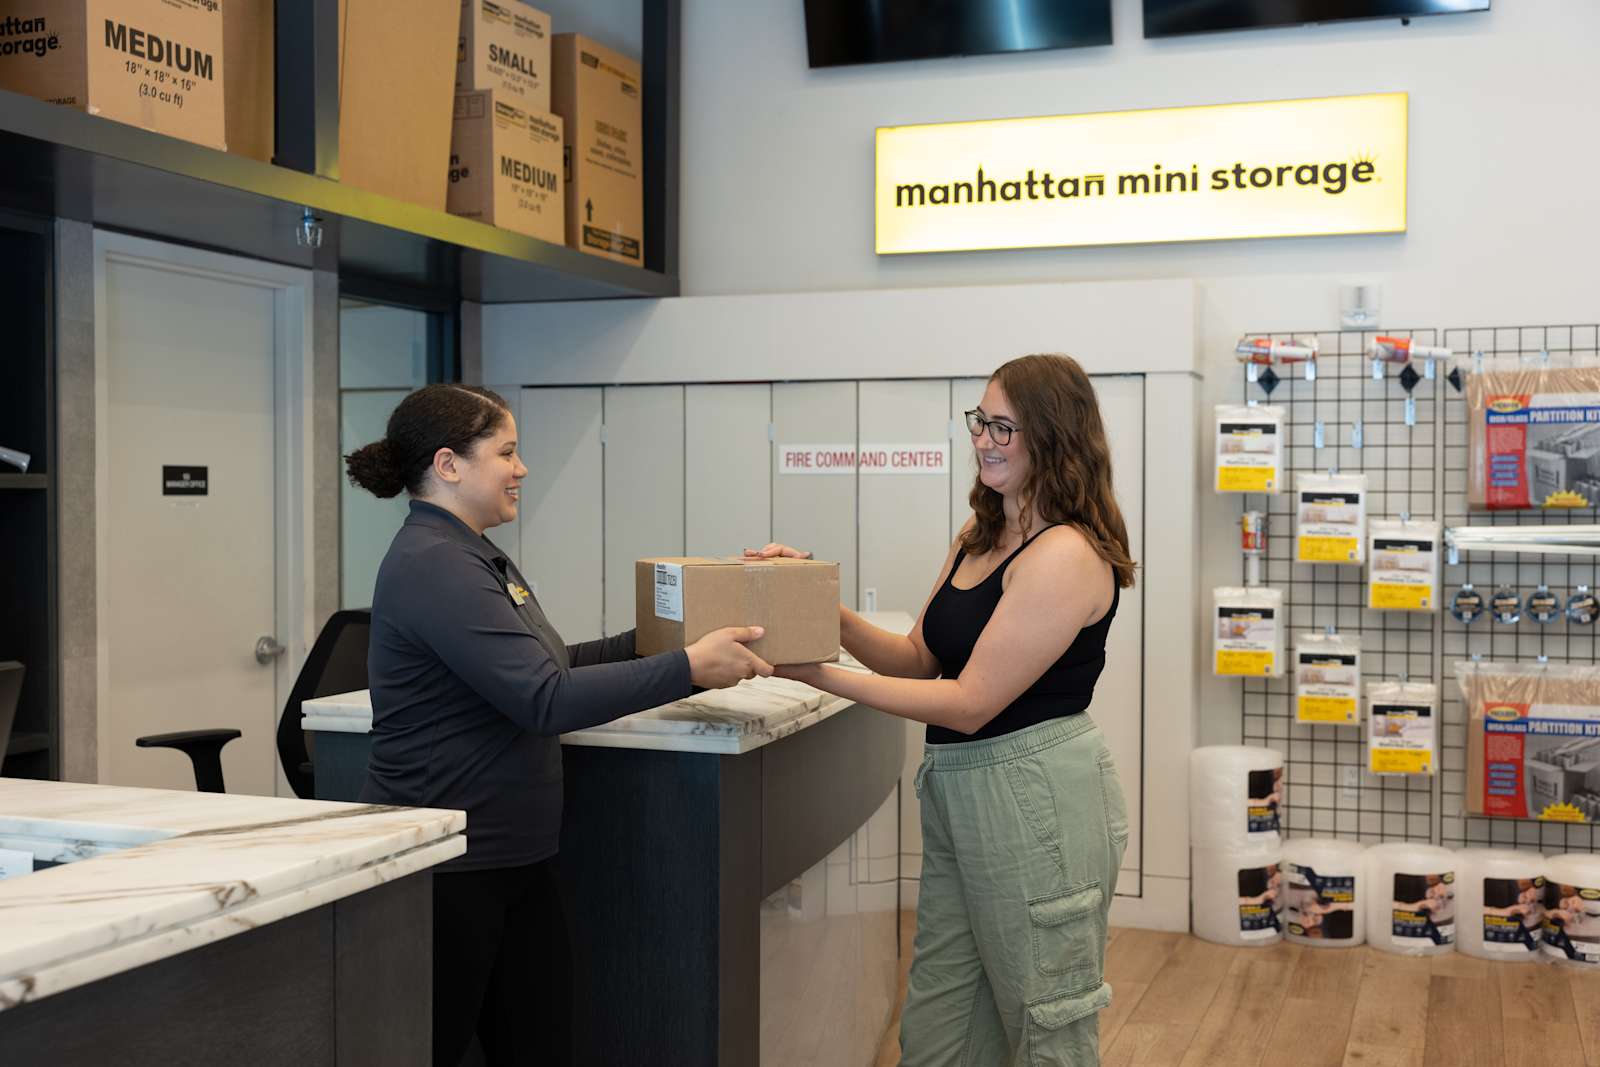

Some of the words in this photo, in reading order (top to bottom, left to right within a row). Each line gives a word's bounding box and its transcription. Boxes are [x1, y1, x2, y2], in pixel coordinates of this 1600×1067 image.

[105, 19, 213, 81] MEDIUM
[488, 43, 537, 79] SMALL
[159, 92, 171, 103] cu
[500, 155, 557, 193] MEDIUM
[896, 163, 1104, 206] manhattan
[1118, 164, 1198, 194] mini
[1211, 158, 1374, 195] storage
[1530, 410, 1584, 424] PARTITION
[785, 451, 812, 467] FIRE
[891, 451, 943, 467] CENTER
[1528, 720, 1583, 735] PARTITION
